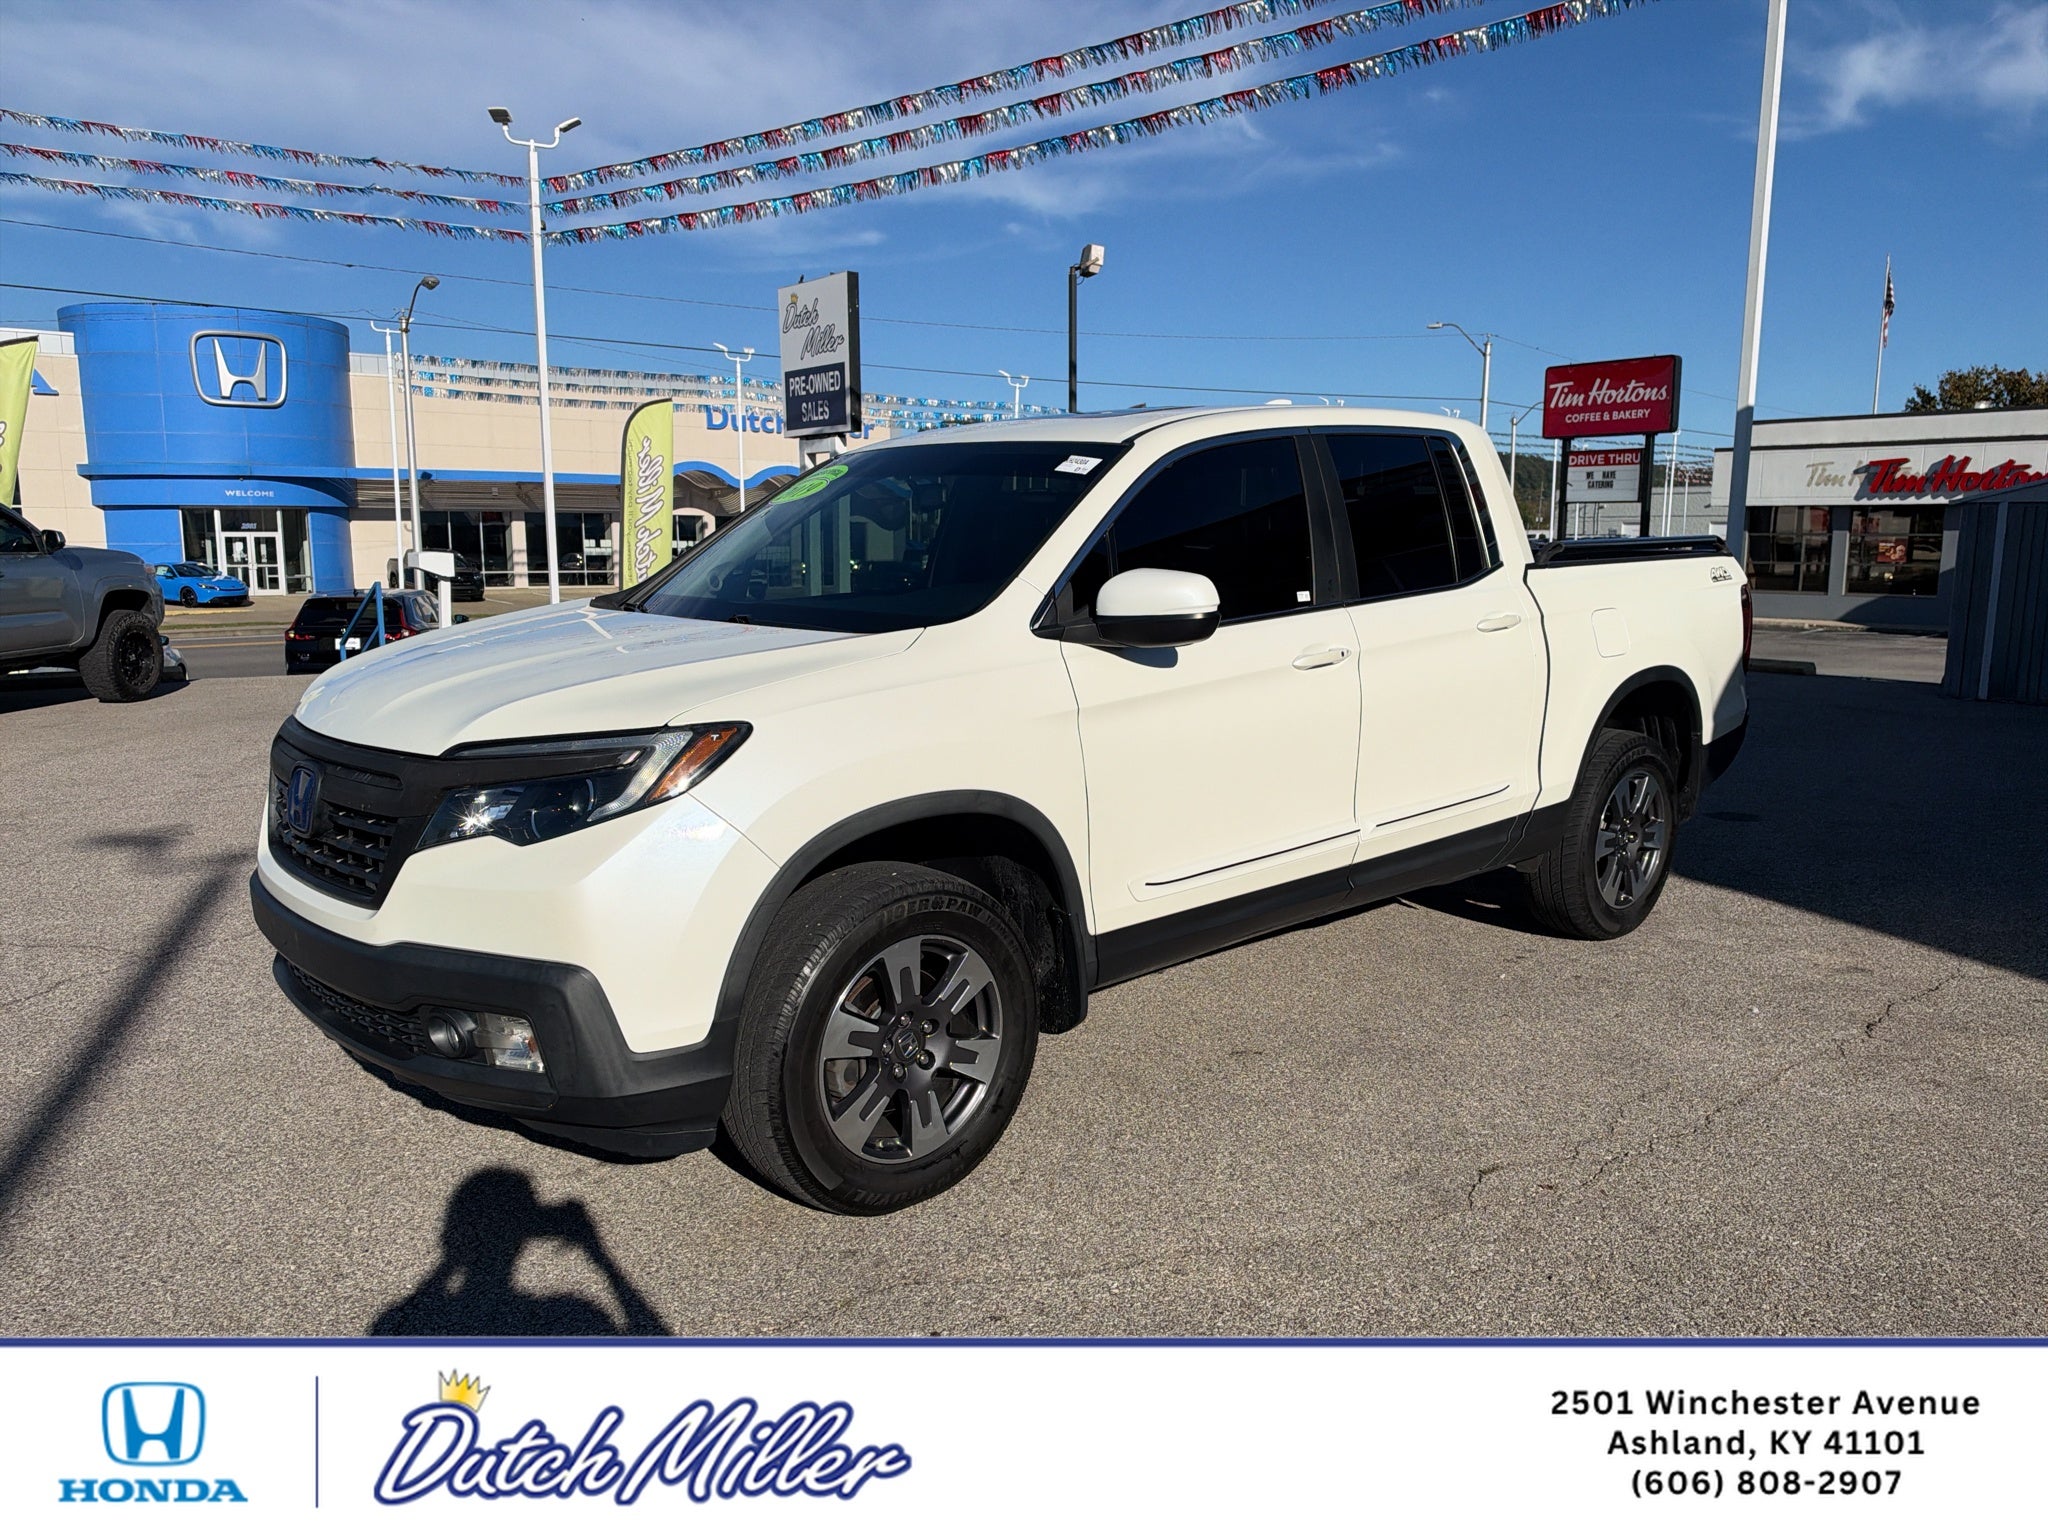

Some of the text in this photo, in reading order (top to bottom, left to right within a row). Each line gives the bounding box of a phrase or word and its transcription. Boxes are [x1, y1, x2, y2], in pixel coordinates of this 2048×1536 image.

[783, 298, 819, 334] Dutch
[801, 323, 845, 360] Miller
[789, 370, 841, 397] PRE-OWNED
[1549, 378, 1669, 409] Tim Hortons
[801, 400, 830, 422] SALES
[1565, 408, 1652, 423] COFFEE & BAKERY
[1569, 453, 1641, 465] DRIVE THRU
[1586, 470, 1617, 480] WE HAVE
[1868, 457, 1926, 494] Tim
[224, 490, 275, 498] WELCOME
[946, 897, 983, 919] PAW
